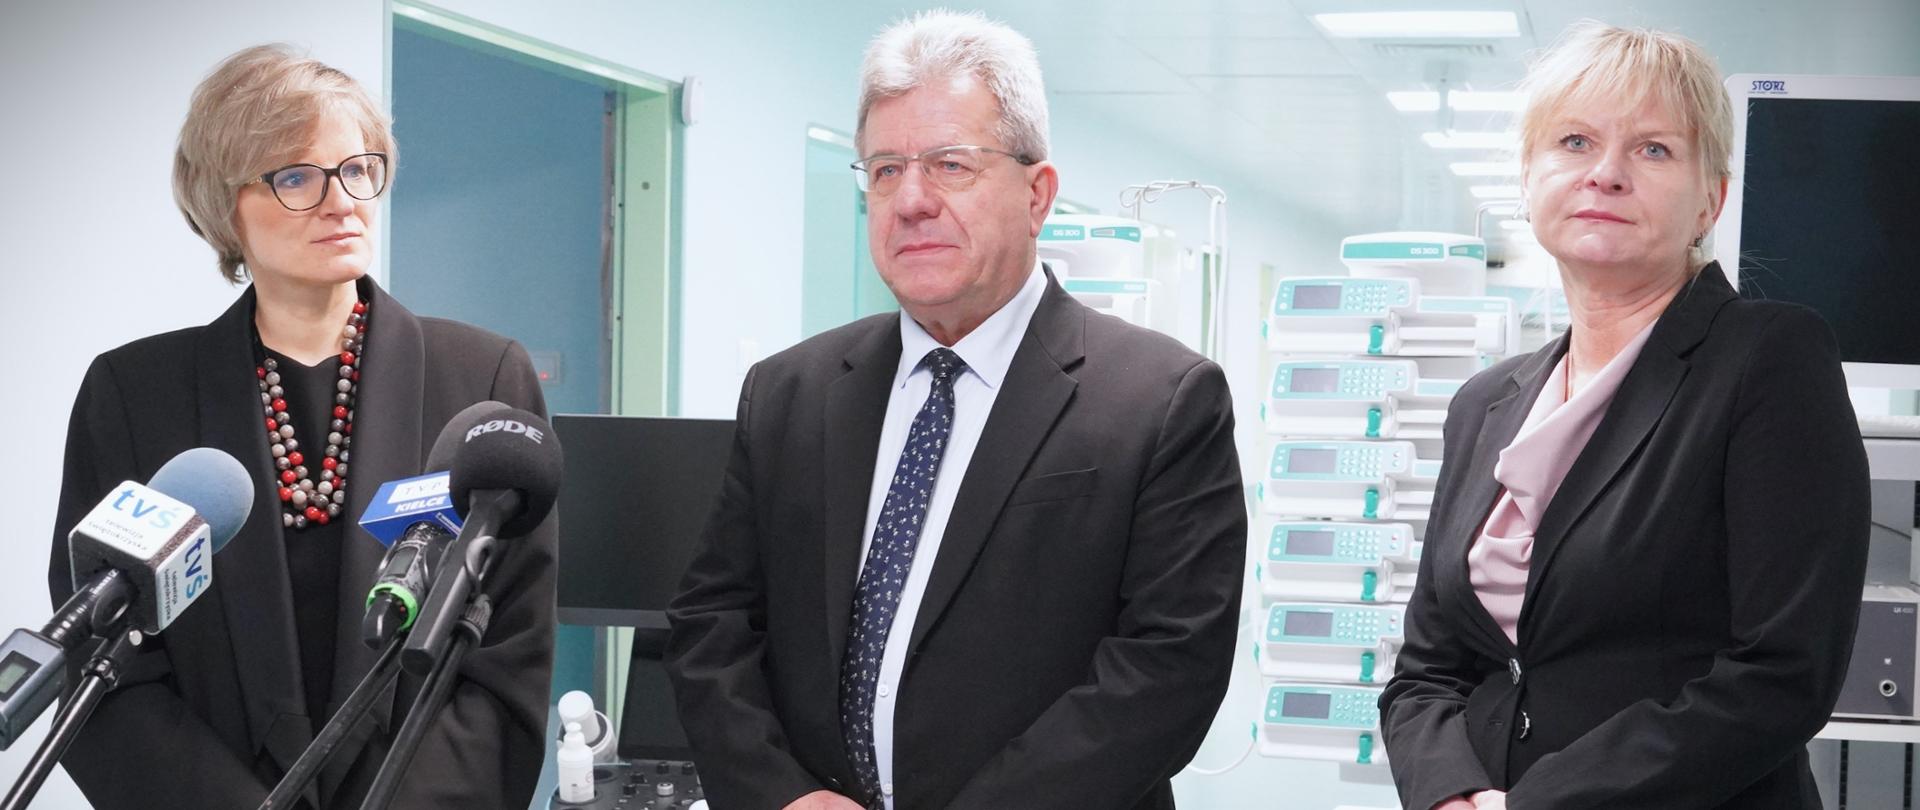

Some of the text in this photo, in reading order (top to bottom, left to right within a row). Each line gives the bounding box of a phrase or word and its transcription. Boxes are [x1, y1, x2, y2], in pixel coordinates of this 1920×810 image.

[1752, 80, 1785, 91] STORZ
[1410, 247, 1422, 255] DS
[465, 420, 544, 444] RØDE
[113, 489, 183, 529] tvś
[395, 496, 447, 513] KIELCE
